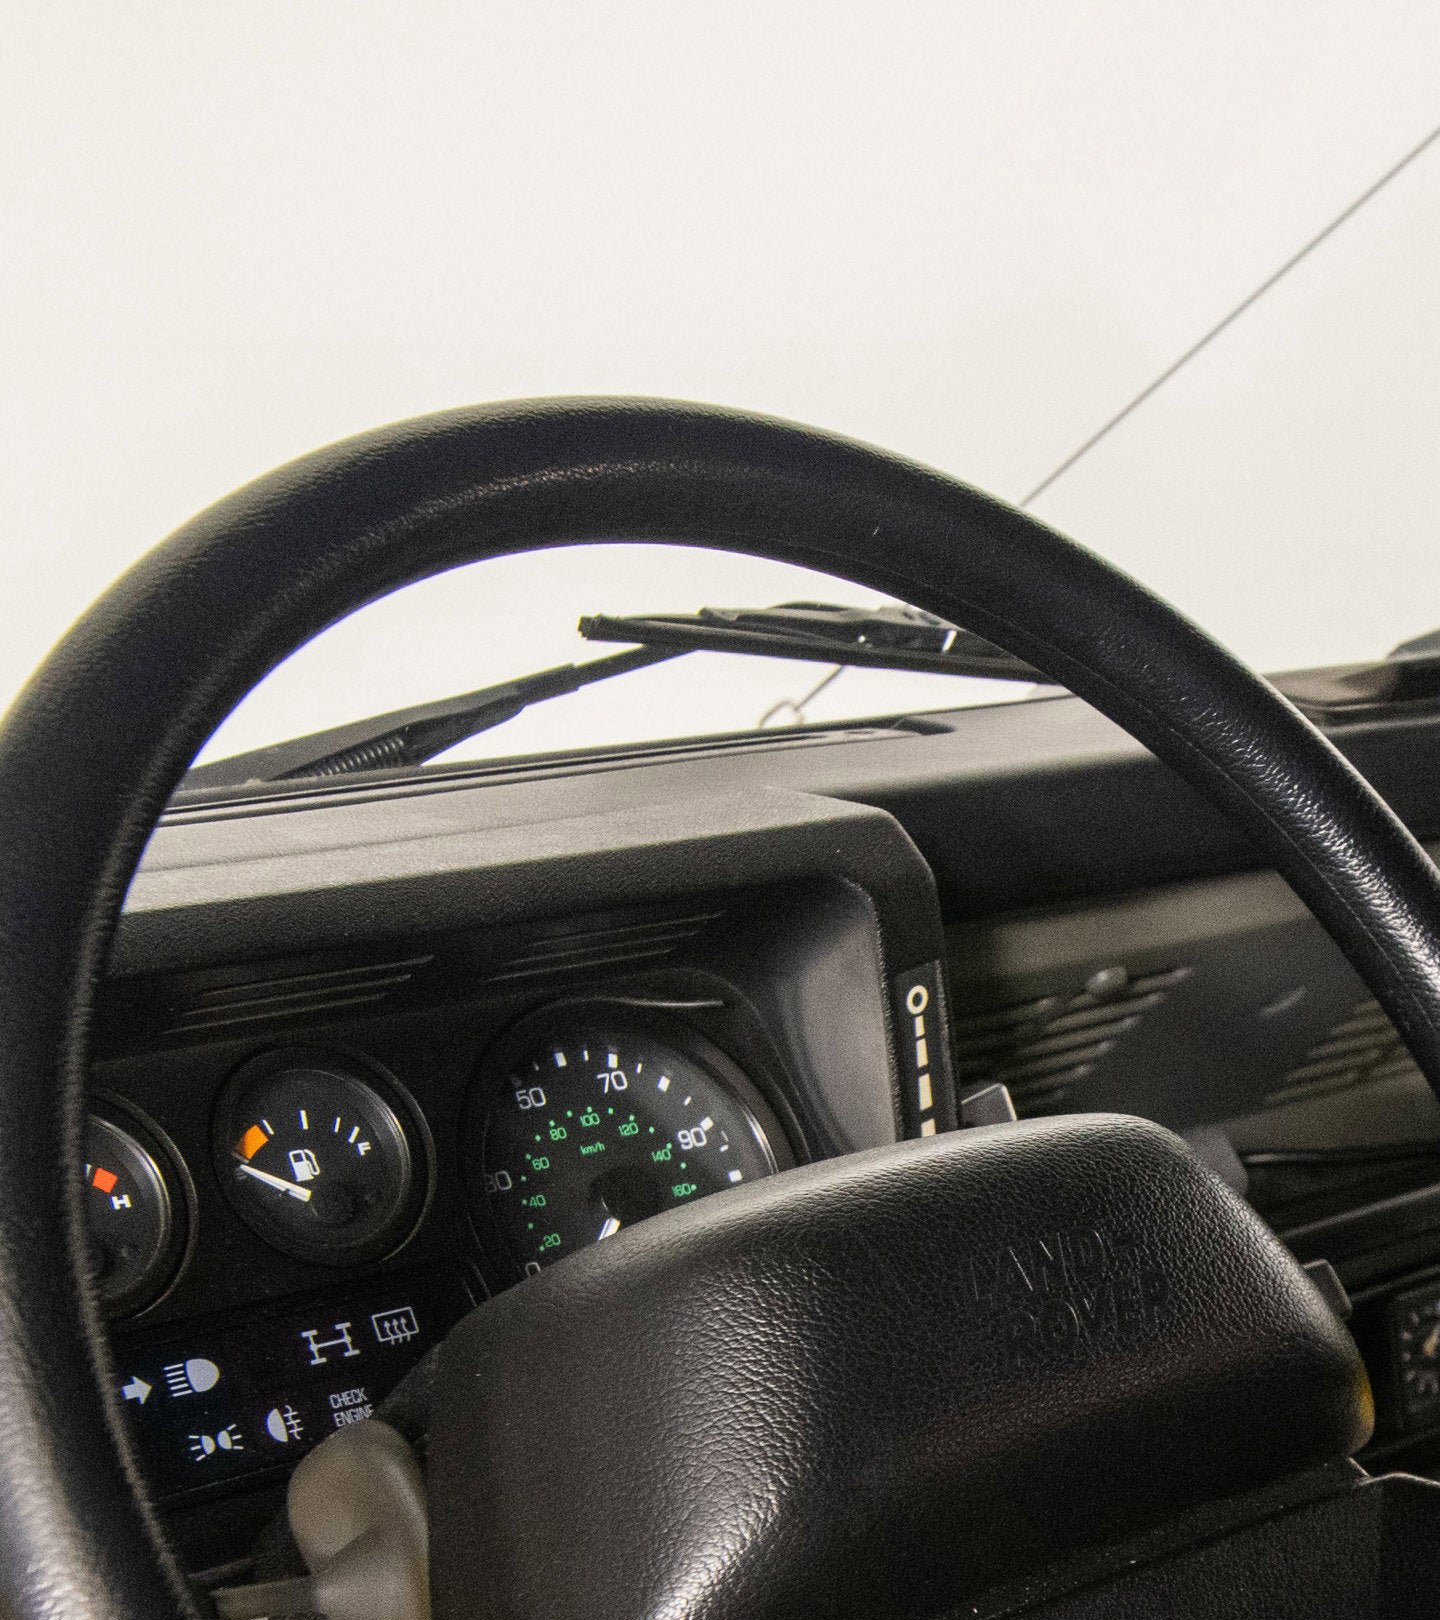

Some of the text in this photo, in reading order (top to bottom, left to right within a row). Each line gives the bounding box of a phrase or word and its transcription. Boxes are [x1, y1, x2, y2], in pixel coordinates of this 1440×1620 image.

[597, 1071, 628, 1094] 70
[516, 1087, 547, 1110] 50
[580, 1113, 600, 1127] 100
[549, 1126, 567, 1141] 80
[618, 1122, 639, 1136] 120
[677, 1127, 708, 1150] 90
[357, 1141, 372, 1156] F
[651, 1149, 672, 1162] 140
[532, 1157, 550, 1170] 60
[111, 1194, 132, 1210] H
[529, 1195, 547, 1207] 40
[543, 1233, 561, 1247] 20
[330, 1387, 368, 1409] CHECK
[334, 1404, 374, 1427] ENGINE
